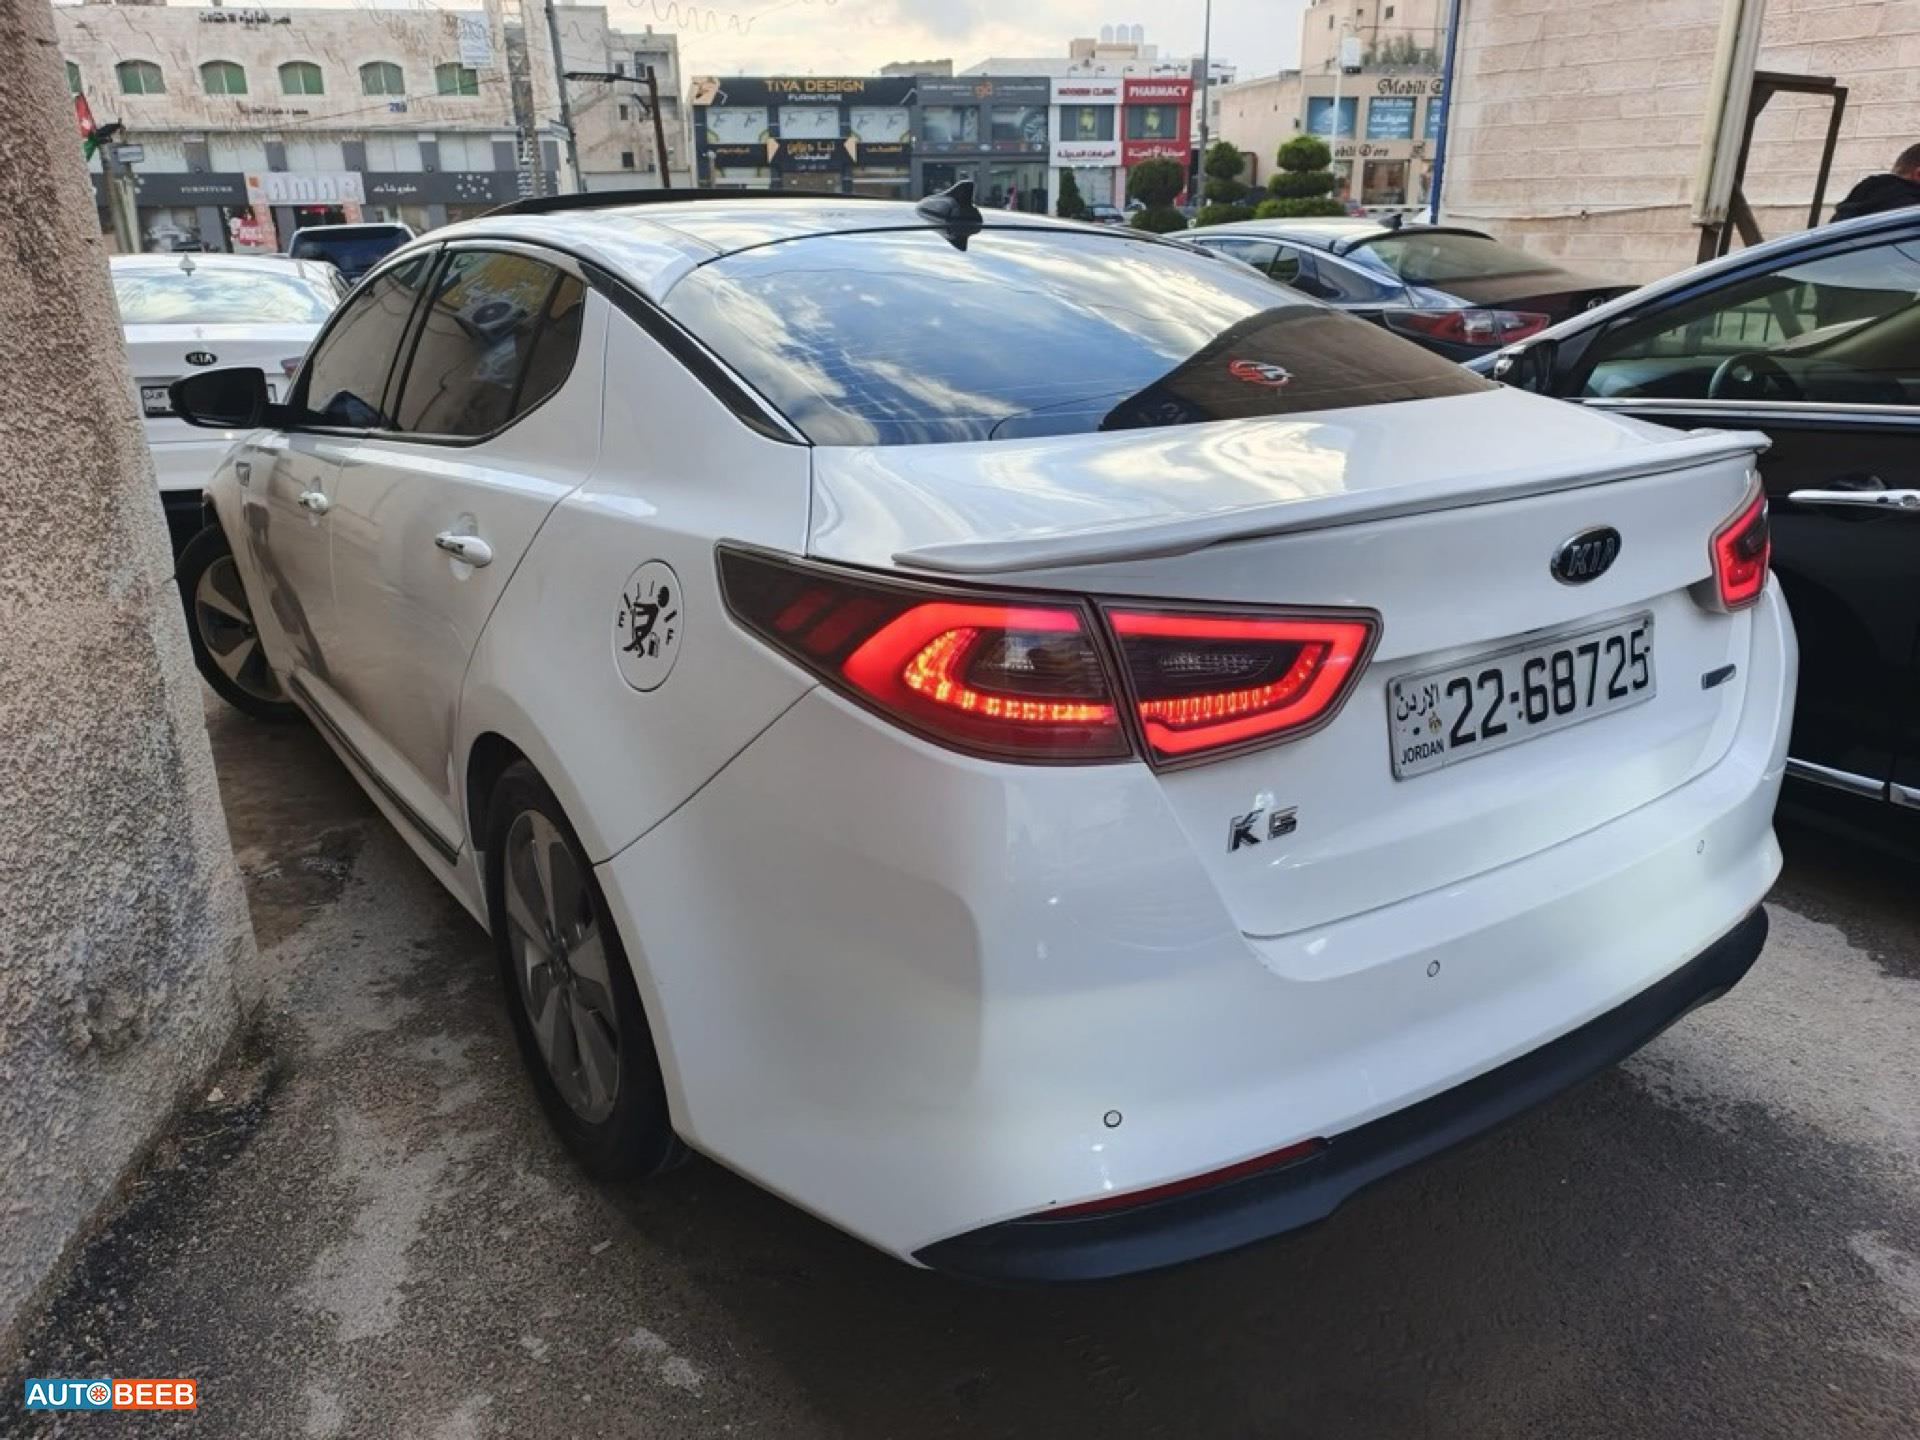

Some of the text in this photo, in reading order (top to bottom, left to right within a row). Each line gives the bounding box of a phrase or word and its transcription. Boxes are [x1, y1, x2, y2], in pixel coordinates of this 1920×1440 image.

[766, 80, 864, 92] TIYA DESIGN
[1129, 85, 1188, 97] PHARMACY
[190, 352, 214, 364] KIA
[1566, 539, 1615, 578] KIA
[1400, 737, 1445, 765] JORDAN
